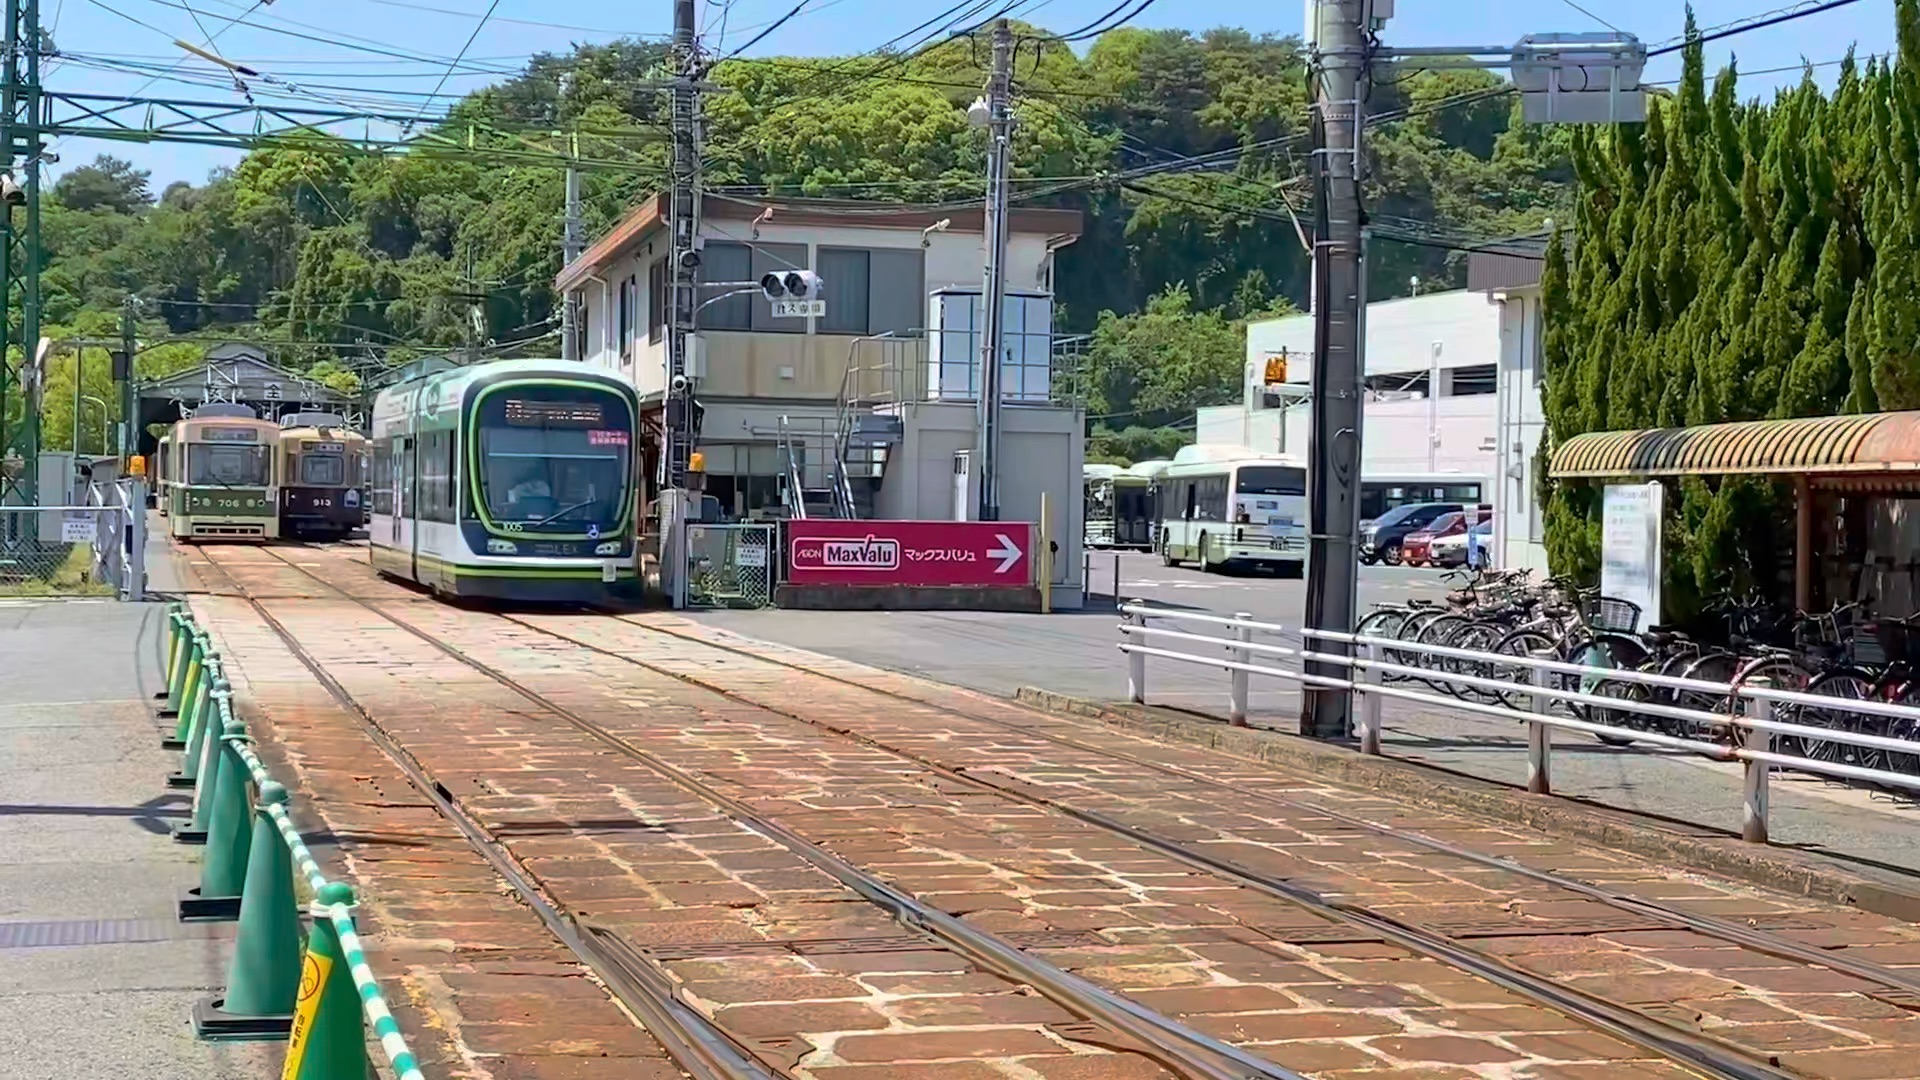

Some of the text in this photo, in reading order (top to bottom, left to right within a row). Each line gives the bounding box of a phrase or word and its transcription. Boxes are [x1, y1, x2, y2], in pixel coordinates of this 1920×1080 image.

[218, 499, 240, 508] 706
[312, 495, 332, 507] 913
[826, 536, 893, 563] MaxValu
[904, 548, 977, 562] マックスバリュ
